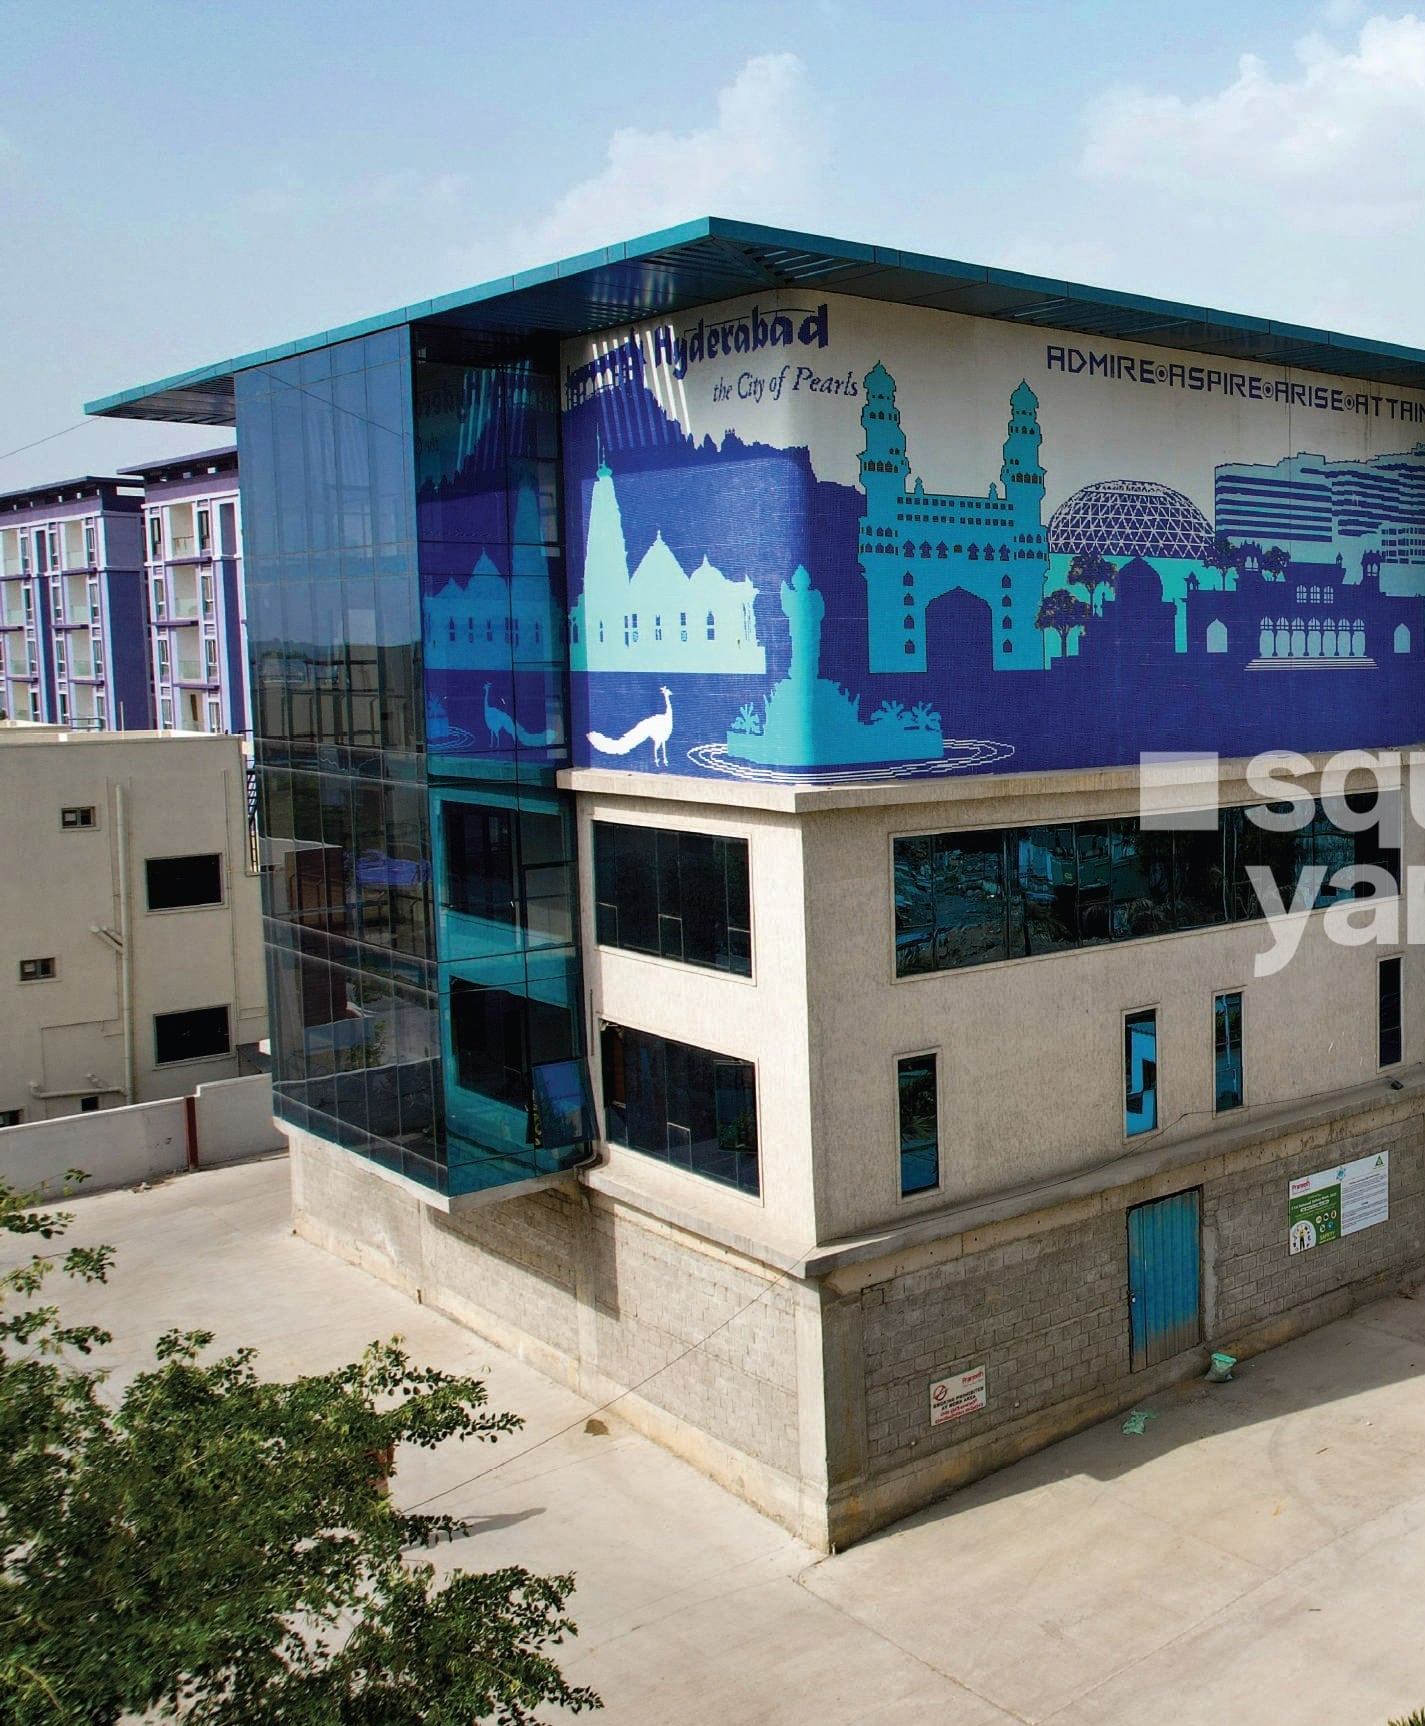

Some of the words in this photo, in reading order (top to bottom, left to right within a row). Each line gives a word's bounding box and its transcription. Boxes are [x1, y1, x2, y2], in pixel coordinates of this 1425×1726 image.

[655, 304, 828, 380] Hyderabad
[713, 377, 732, 402] the
[738, 372, 764, 402] City
[769, 365, 790, 399] of
[792, 367, 858, 397] Pearls
[1046, 345, 1155, 384] ADMIRE
[1170, 363, 1262, 400] ASPIRE
[1275, 380, 1344, 412] ARISE
